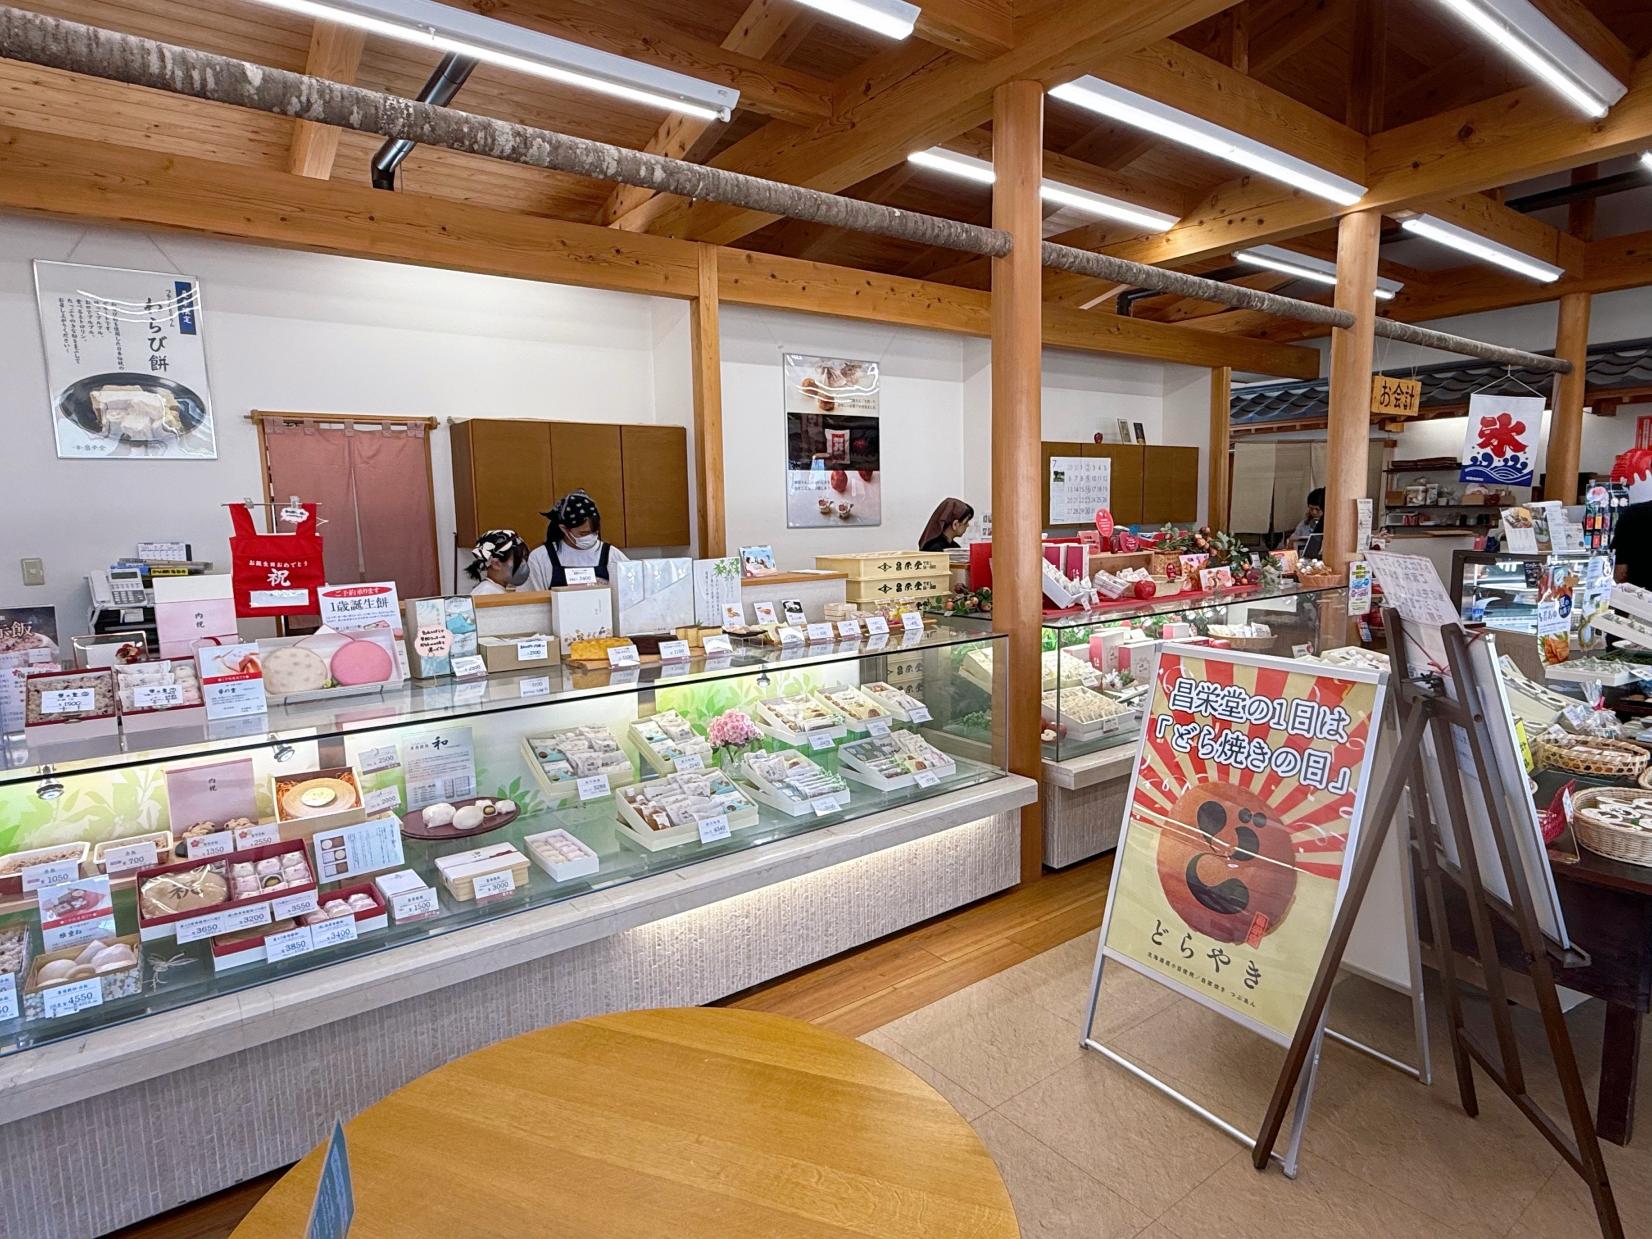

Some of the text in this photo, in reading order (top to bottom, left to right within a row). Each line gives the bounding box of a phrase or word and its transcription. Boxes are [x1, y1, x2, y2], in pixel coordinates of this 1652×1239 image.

[144, 297, 169, 372] わらび餅
[1379, 380, 1415, 410] お会計
[1477, 412, 1528, 459] 氷
[266, 568, 291, 586] 祝
[331, 597, 388, 611] 1歳誕生餅
[1170, 679, 1349, 742] 昌栄堂の1日は
[432, 736, 449, 750] 和
[1155, 716, 1353, 794] 『どら焼きの日』
[1151, 919, 1262, 990] どらやき
